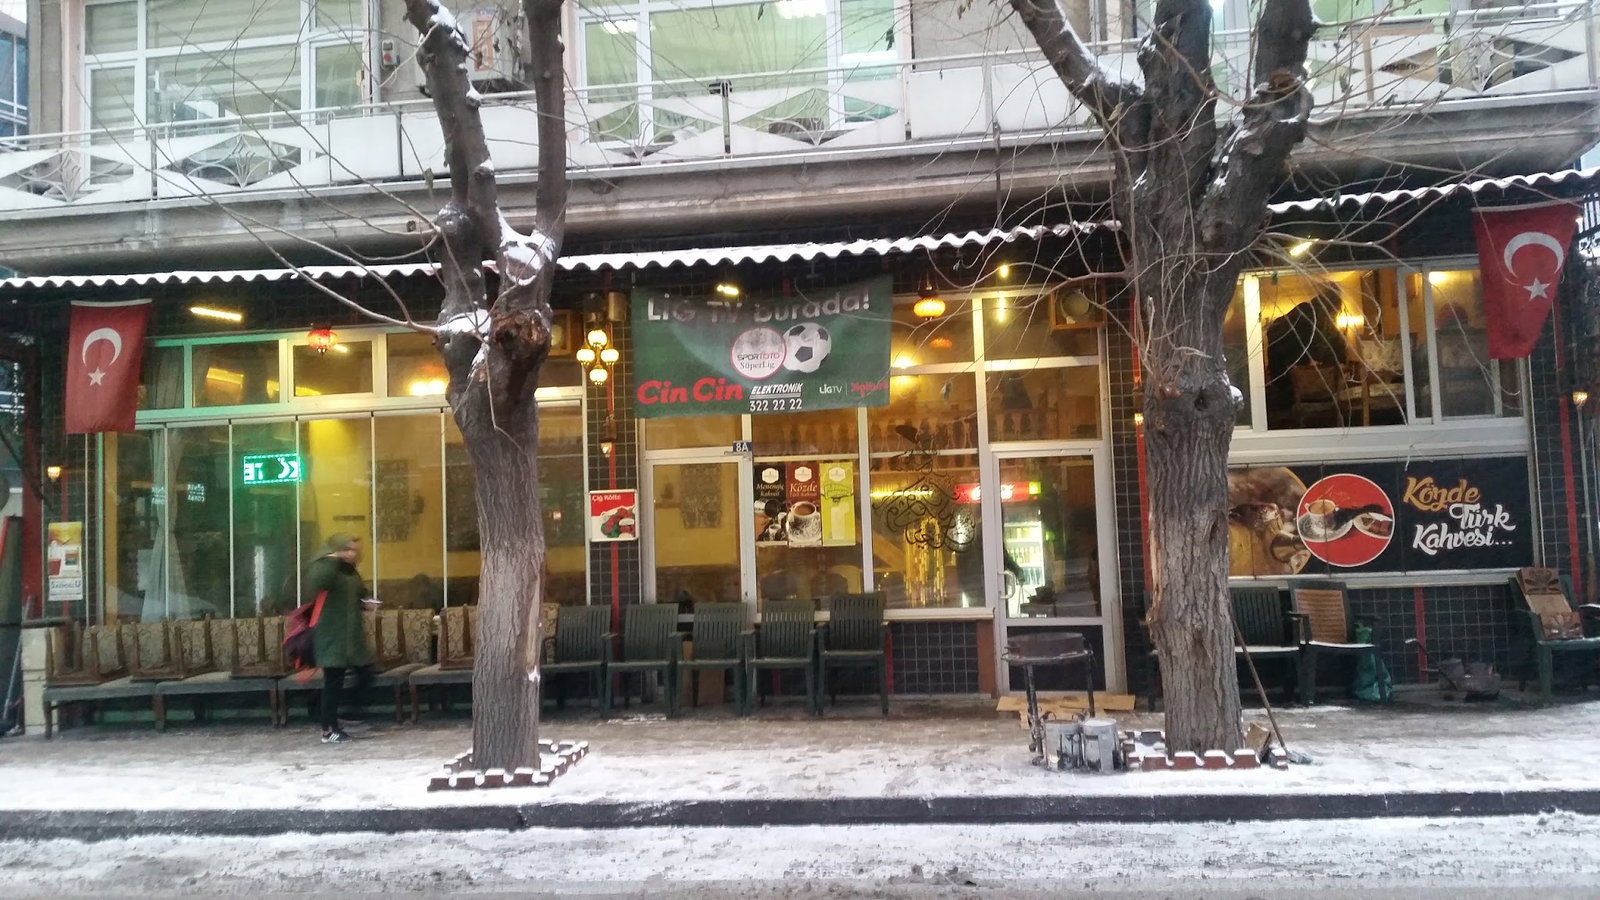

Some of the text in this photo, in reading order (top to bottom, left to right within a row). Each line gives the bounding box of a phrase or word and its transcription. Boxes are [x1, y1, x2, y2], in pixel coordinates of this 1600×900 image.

[706, 300, 743, 323] TV
[753, 292, 870, 322] burada!
[636, 377, 743, 405] Cin Cin
[750, 399, 802, 411] 322 22 22
[735, 442, 749, 452] 8A
[790, 481, 818, 492] Közde
[1402, 476, 1481, 512] Közde
[1449, 503, 1516, 531] Türk
